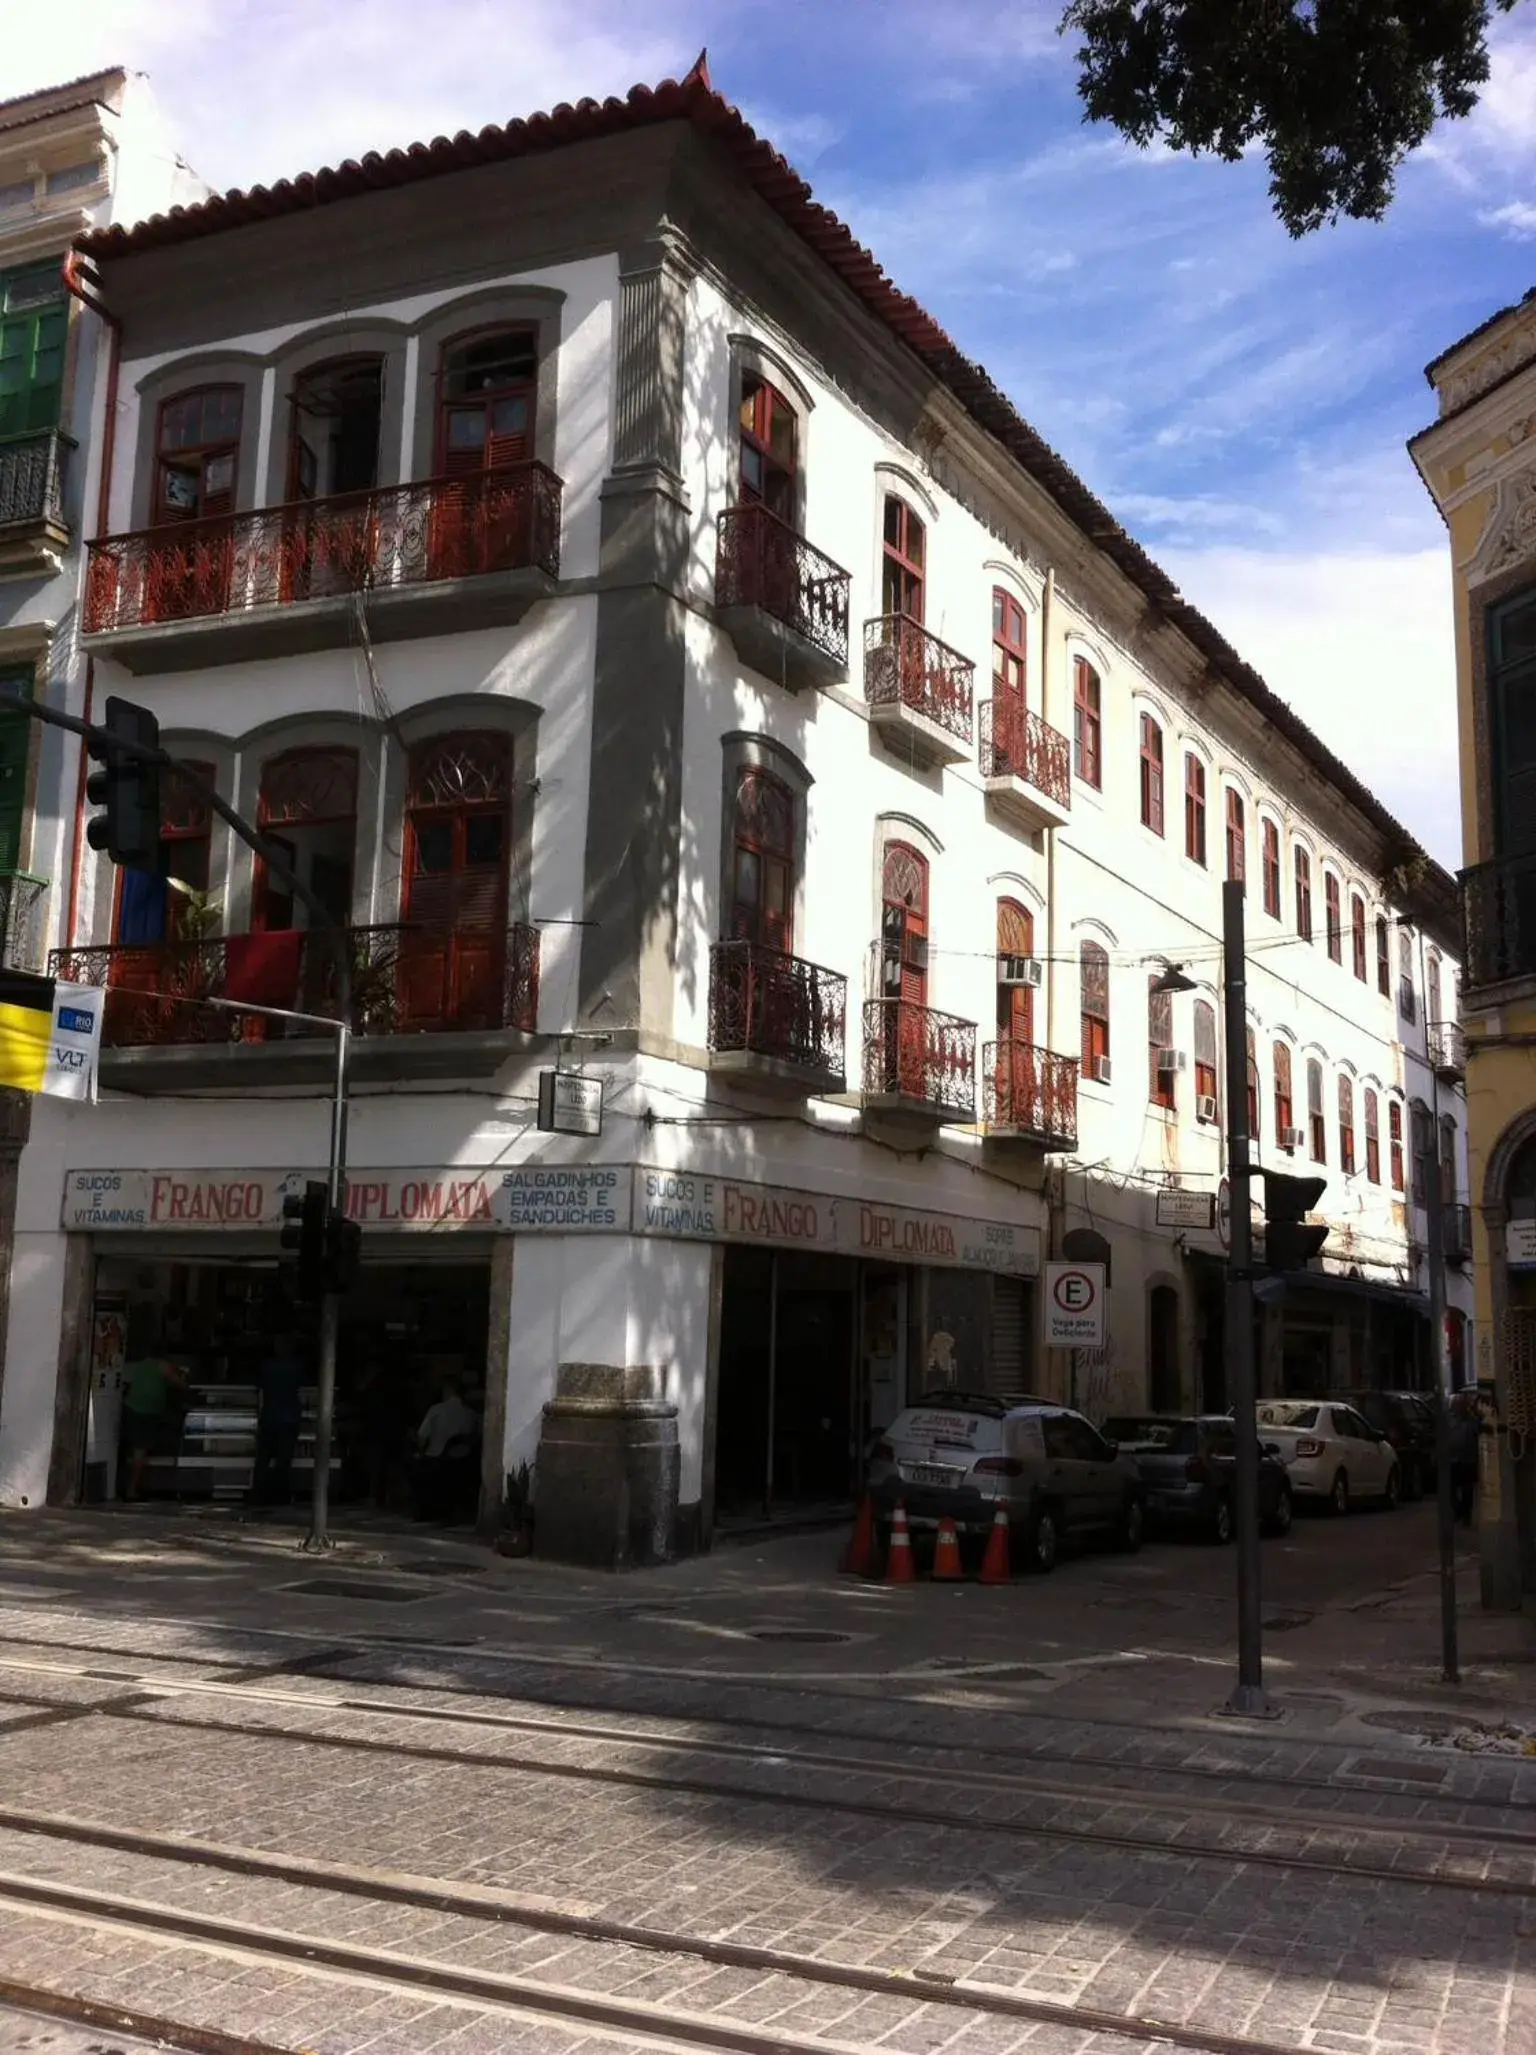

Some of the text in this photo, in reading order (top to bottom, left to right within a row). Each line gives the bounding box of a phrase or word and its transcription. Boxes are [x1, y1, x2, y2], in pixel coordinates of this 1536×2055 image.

[75, 1015, 92, 1027] RIO
[55, 1047, 88, 1068] VLT
[76, 1176, 122, 1190] SUCOS
[502, 1172, 617, 1188] SALGADINHOS
[511, 1190, 608, 1206] EMPADAS E
[646, 1175, 714, 1204] SUCOS E
[93, 1192, 103, 1207] E
[150, 1176, 264, 1222] FRANGO
[74, 1209, 144, 1223] VITAMINAS
[645, 1205, 714, 1233] VITAMINAS
[723, 1184, 957, 1256] FRANGO DIPLOMATA
[1065, 1279, 1083, 1304] E
